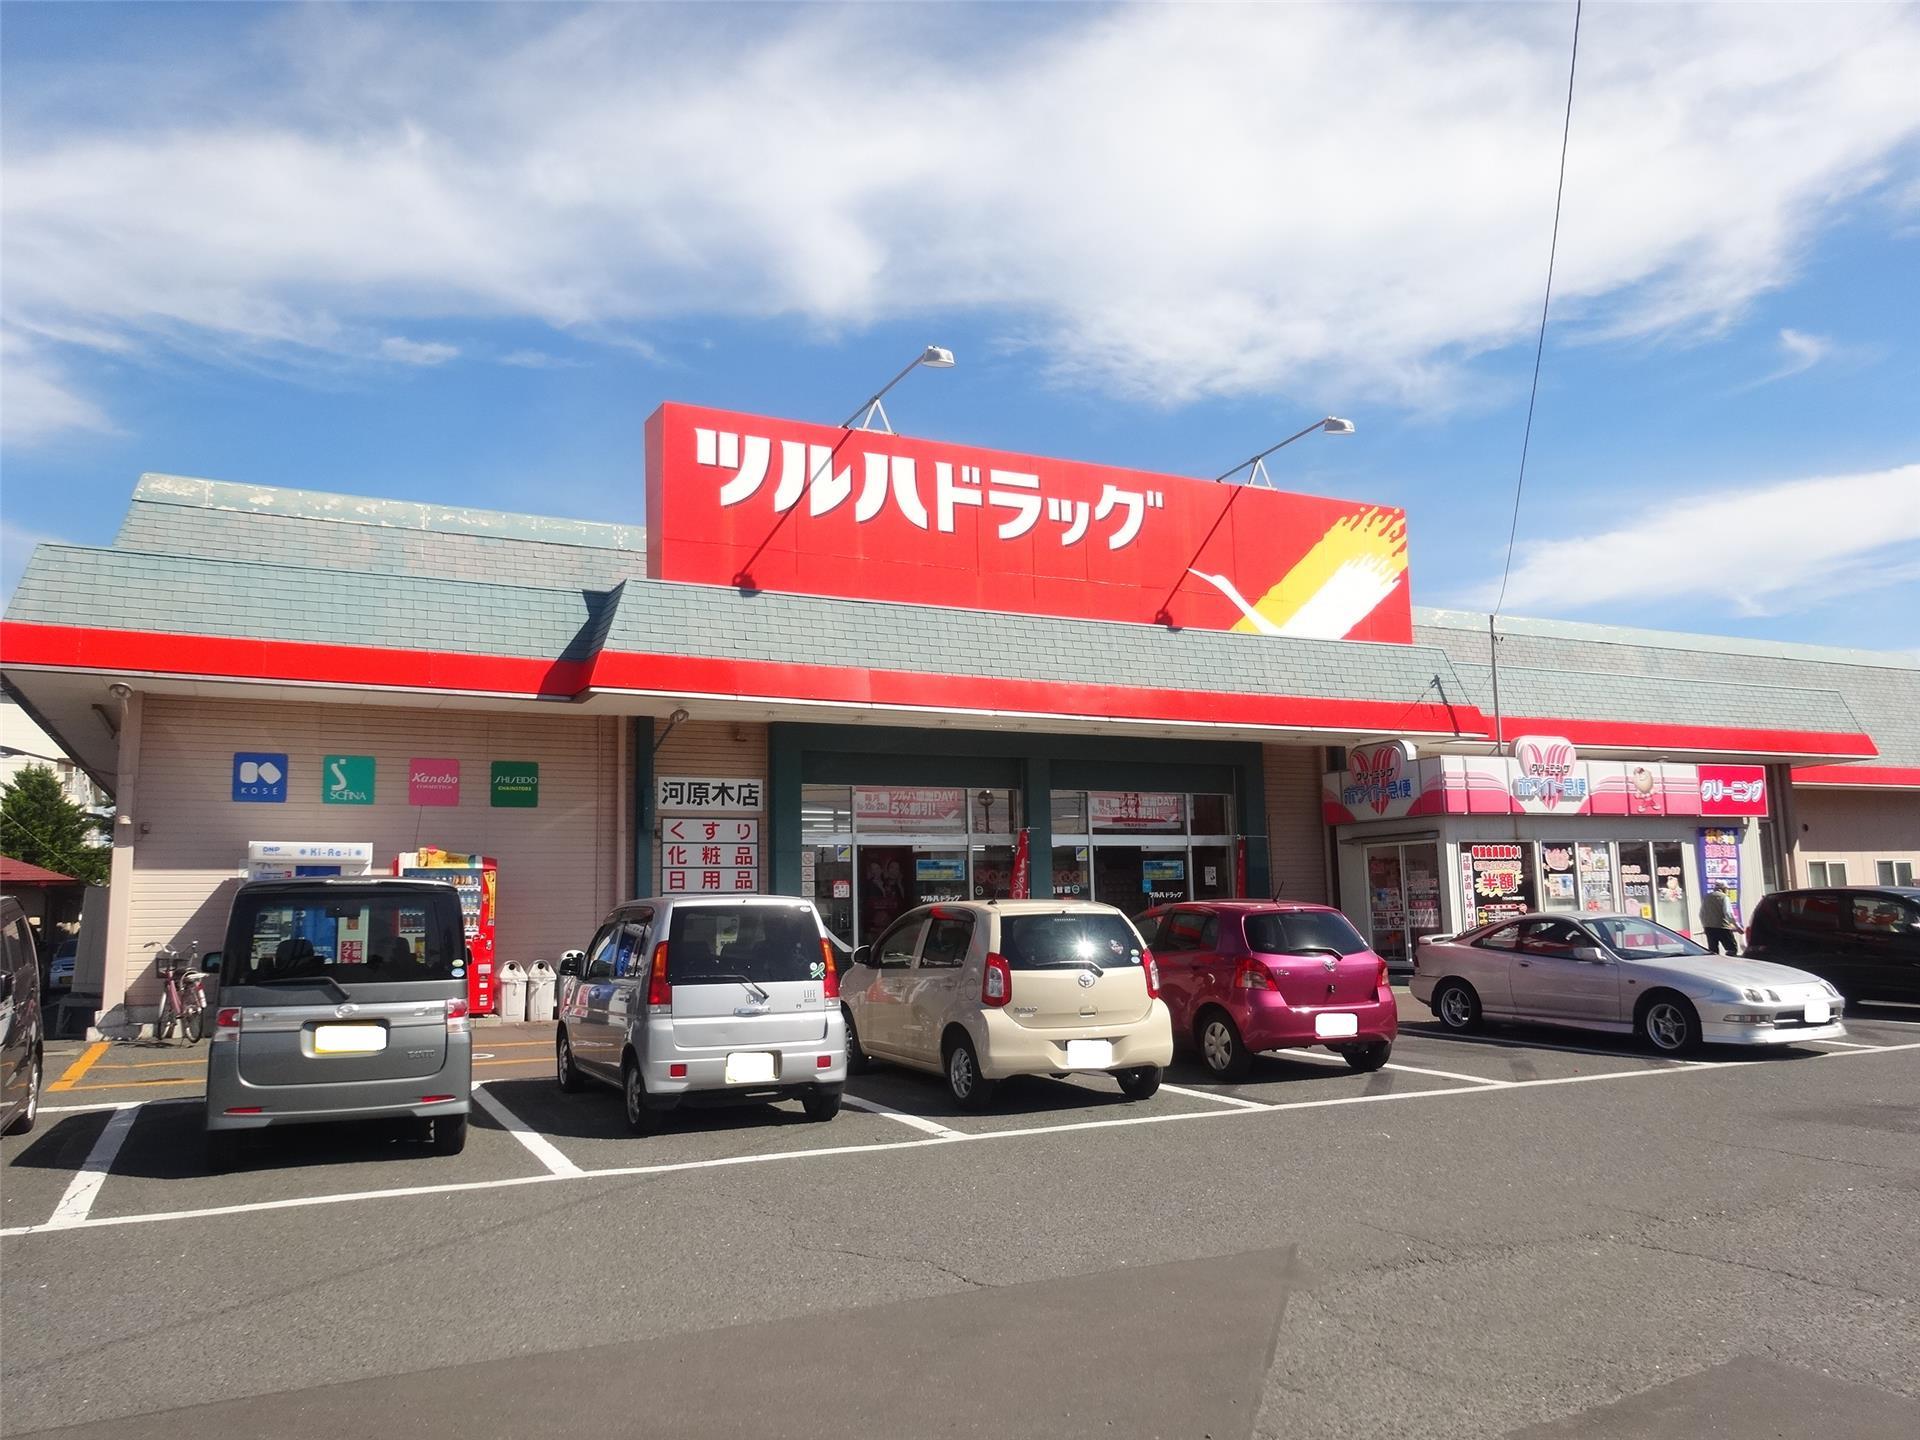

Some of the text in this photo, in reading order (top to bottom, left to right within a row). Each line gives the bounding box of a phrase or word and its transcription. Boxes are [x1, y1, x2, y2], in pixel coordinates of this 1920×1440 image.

[695, 427, 1164, 551] ツルハドラッグ
[412, 772, 458, 784] Kanebo
[1356, 767, 1395, 780] クリーニング
[1530, 763, 1571, 775] クリーニング
[494, 776, 537, 784] SHISEIDO
[1516, 777, 1586, 797] ホワイト急便
[662, 782, 759, 806] 河原木店
[1344, 779, 1411, 804] ホワイト急便
[1702, 780, 1763, 802] クリーニング
[670, 822, 751, 840] くすり
[668, 846, 753, 865] 化粧品
[669, 871, 753, 890] 日用品
[1483, 873, 1515, 891] 半額
